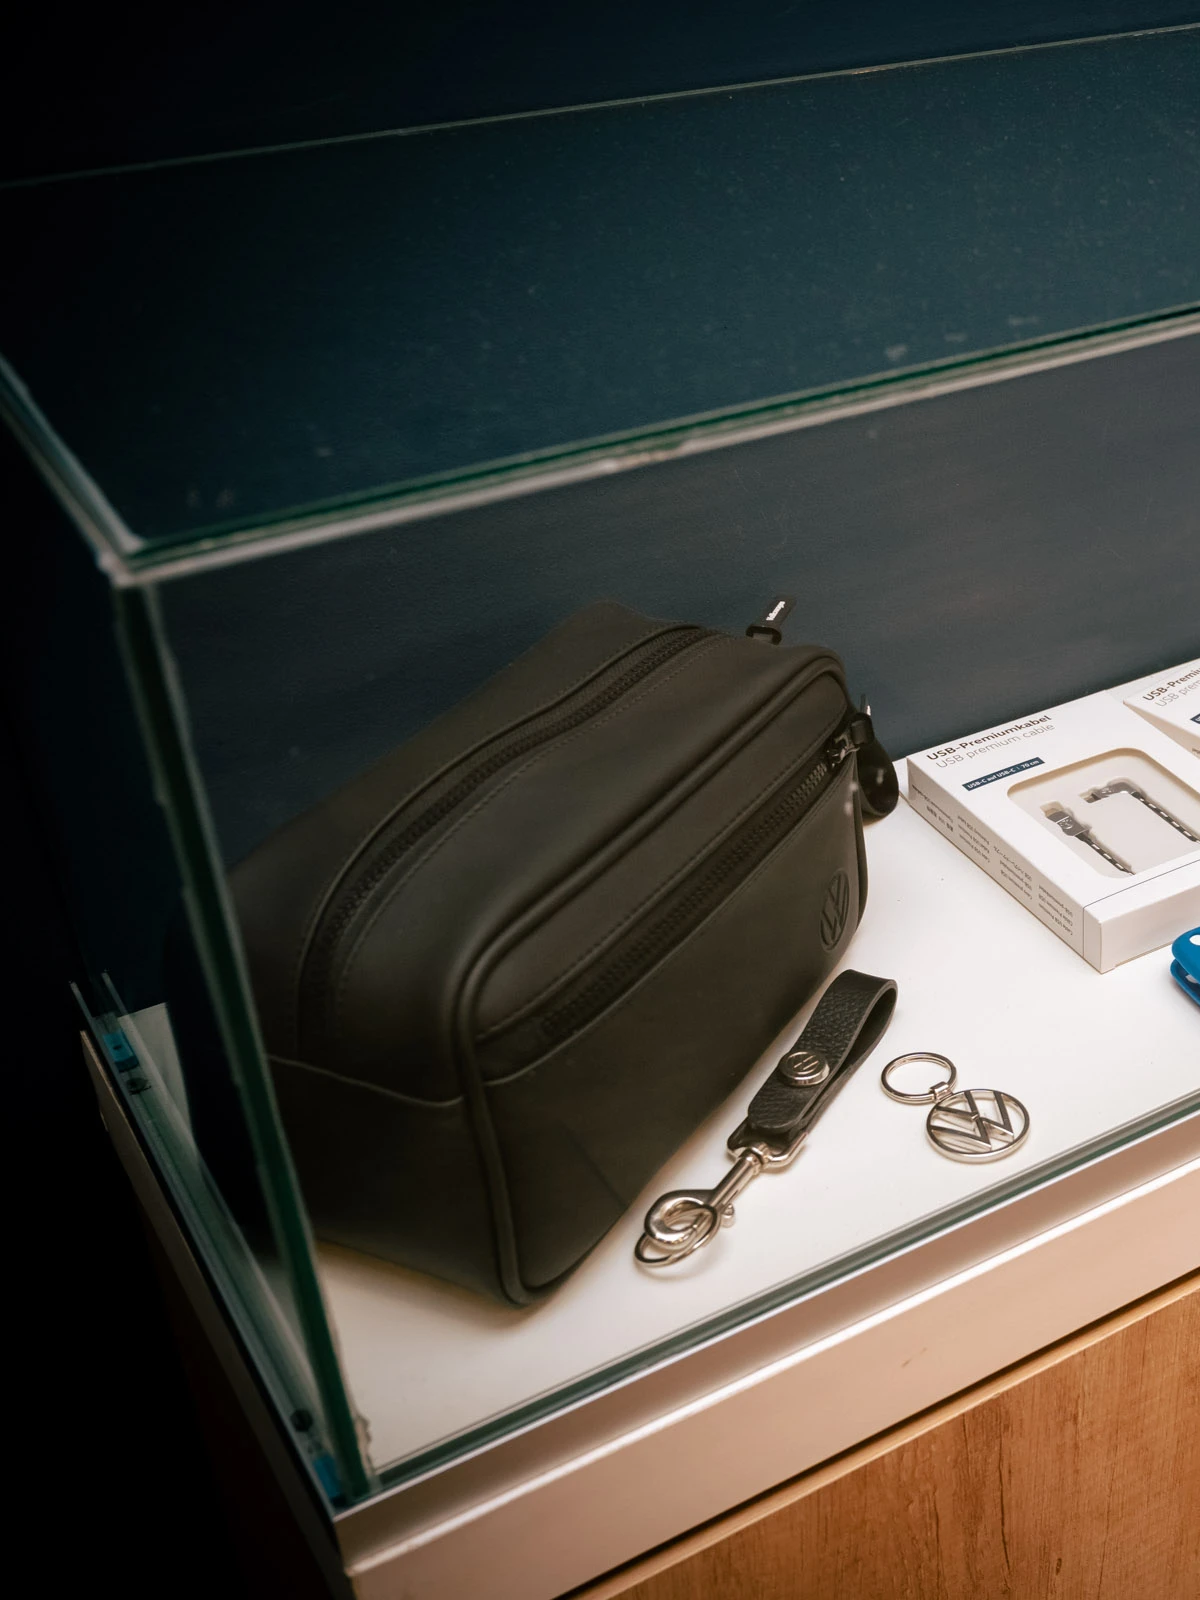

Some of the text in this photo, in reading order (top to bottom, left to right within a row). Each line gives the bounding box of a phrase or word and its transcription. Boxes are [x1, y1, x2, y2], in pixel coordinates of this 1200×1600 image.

[1154, 692, 1180, 707] USB
[926, 715, 1053, 760] USB-Premiumkabel
[935, 724, 1056, 768] USB premium cable
[967, 778, 987, 789] USB-C
[997, 767, 1016, 779] USB-C
